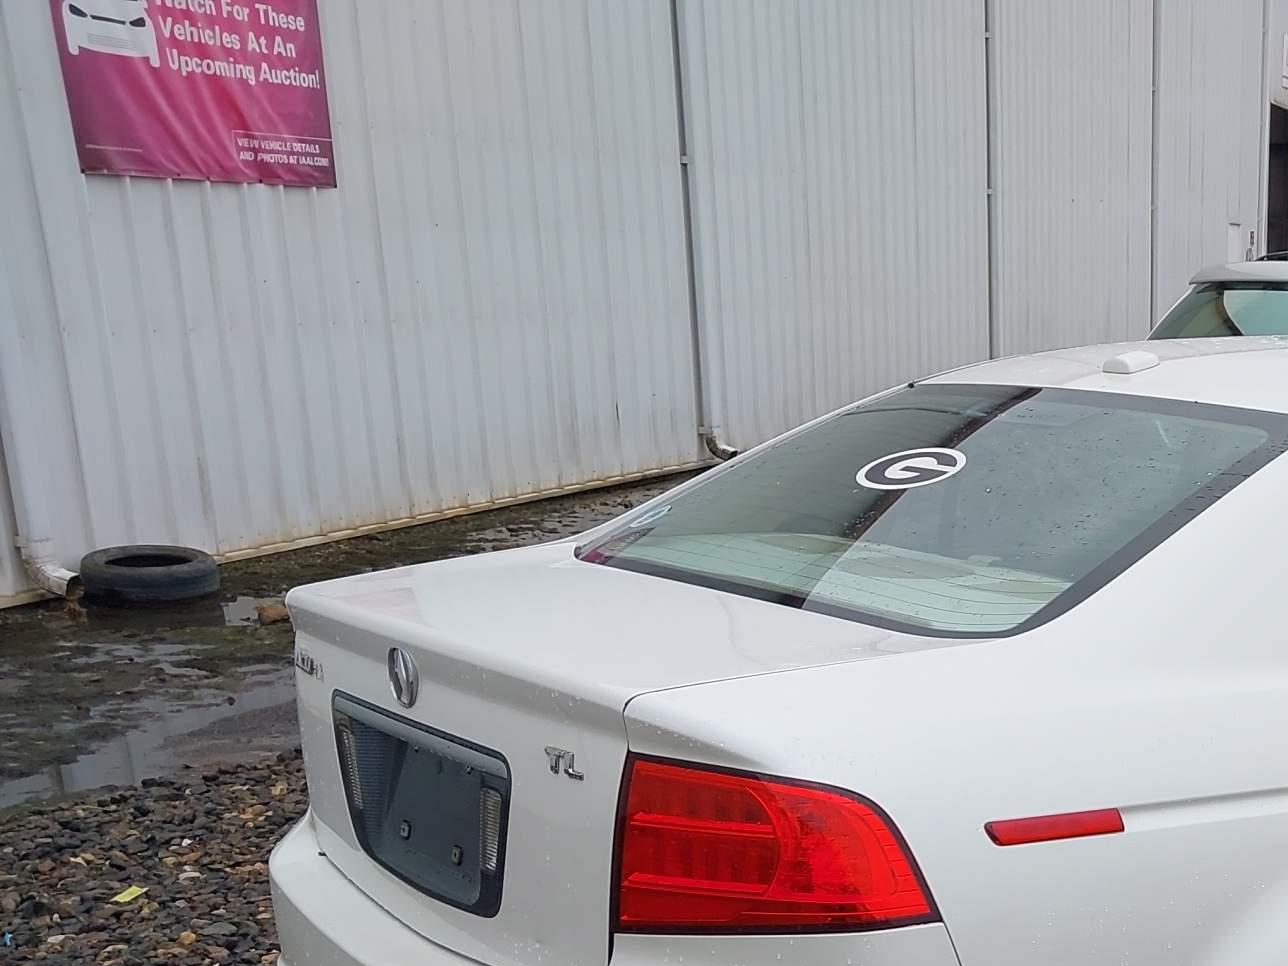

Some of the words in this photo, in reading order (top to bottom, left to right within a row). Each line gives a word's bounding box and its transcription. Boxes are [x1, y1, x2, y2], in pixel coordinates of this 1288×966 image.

[221, 0, 250, 22] For
[255, 3, 305, 32] These
[158, 15, 241, 50] Vehicles
[248, 31, 268, 54] At
[273, 35, 297, 58] An
[166, 47, 256, 86] Upcoming
[259, 62, 321, 89] Auction!
[237, 138, 259, 148] VIEW
[260, 140, 291, 151] VEHICLE
[292, 143, 320, 154] DETAILS
[239, 151, 255, 161] AND
[257, 153, 288, 164] PHOTOS
[289, 155, 297, 165] AT
[544, 745, 585, 781] TL
